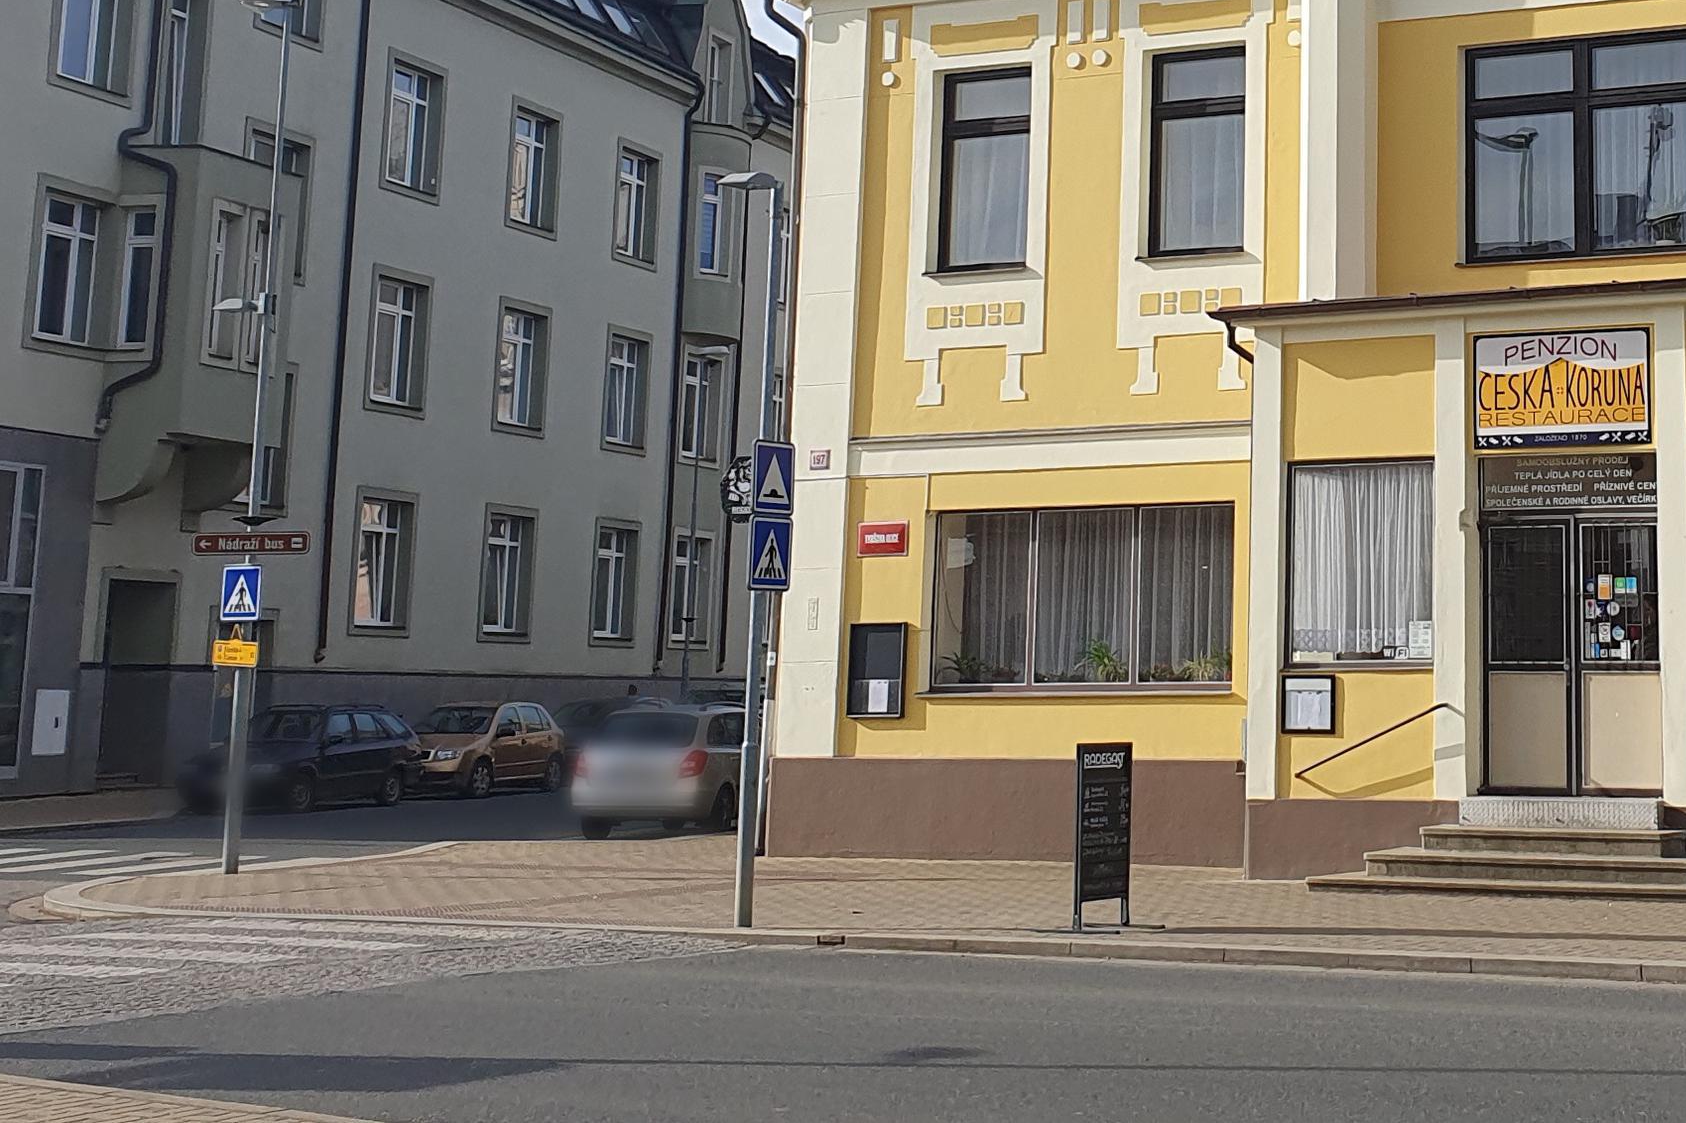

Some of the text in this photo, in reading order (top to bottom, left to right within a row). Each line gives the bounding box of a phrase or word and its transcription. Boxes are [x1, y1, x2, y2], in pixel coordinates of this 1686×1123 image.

[1504, 336, 1617, 367] PENZION
[1565, 361, 1646, 408] KORUNA
[1478, 406, 1646, 427] RESTAURACE
[812, 454, 826, 465] 197
[1593, 455, 1629, 466] PRODEJ
[1572, 469, 1586, 478] PO
[1587, 467, 1611, 478] CELÝ
[1613, 468, 1633, 478] DEN
[1545, 497, 1551, 506] A
[218, 537, 285, 550] Nádraží bus
[1083, 752, 1126, 769] RADEGAST
